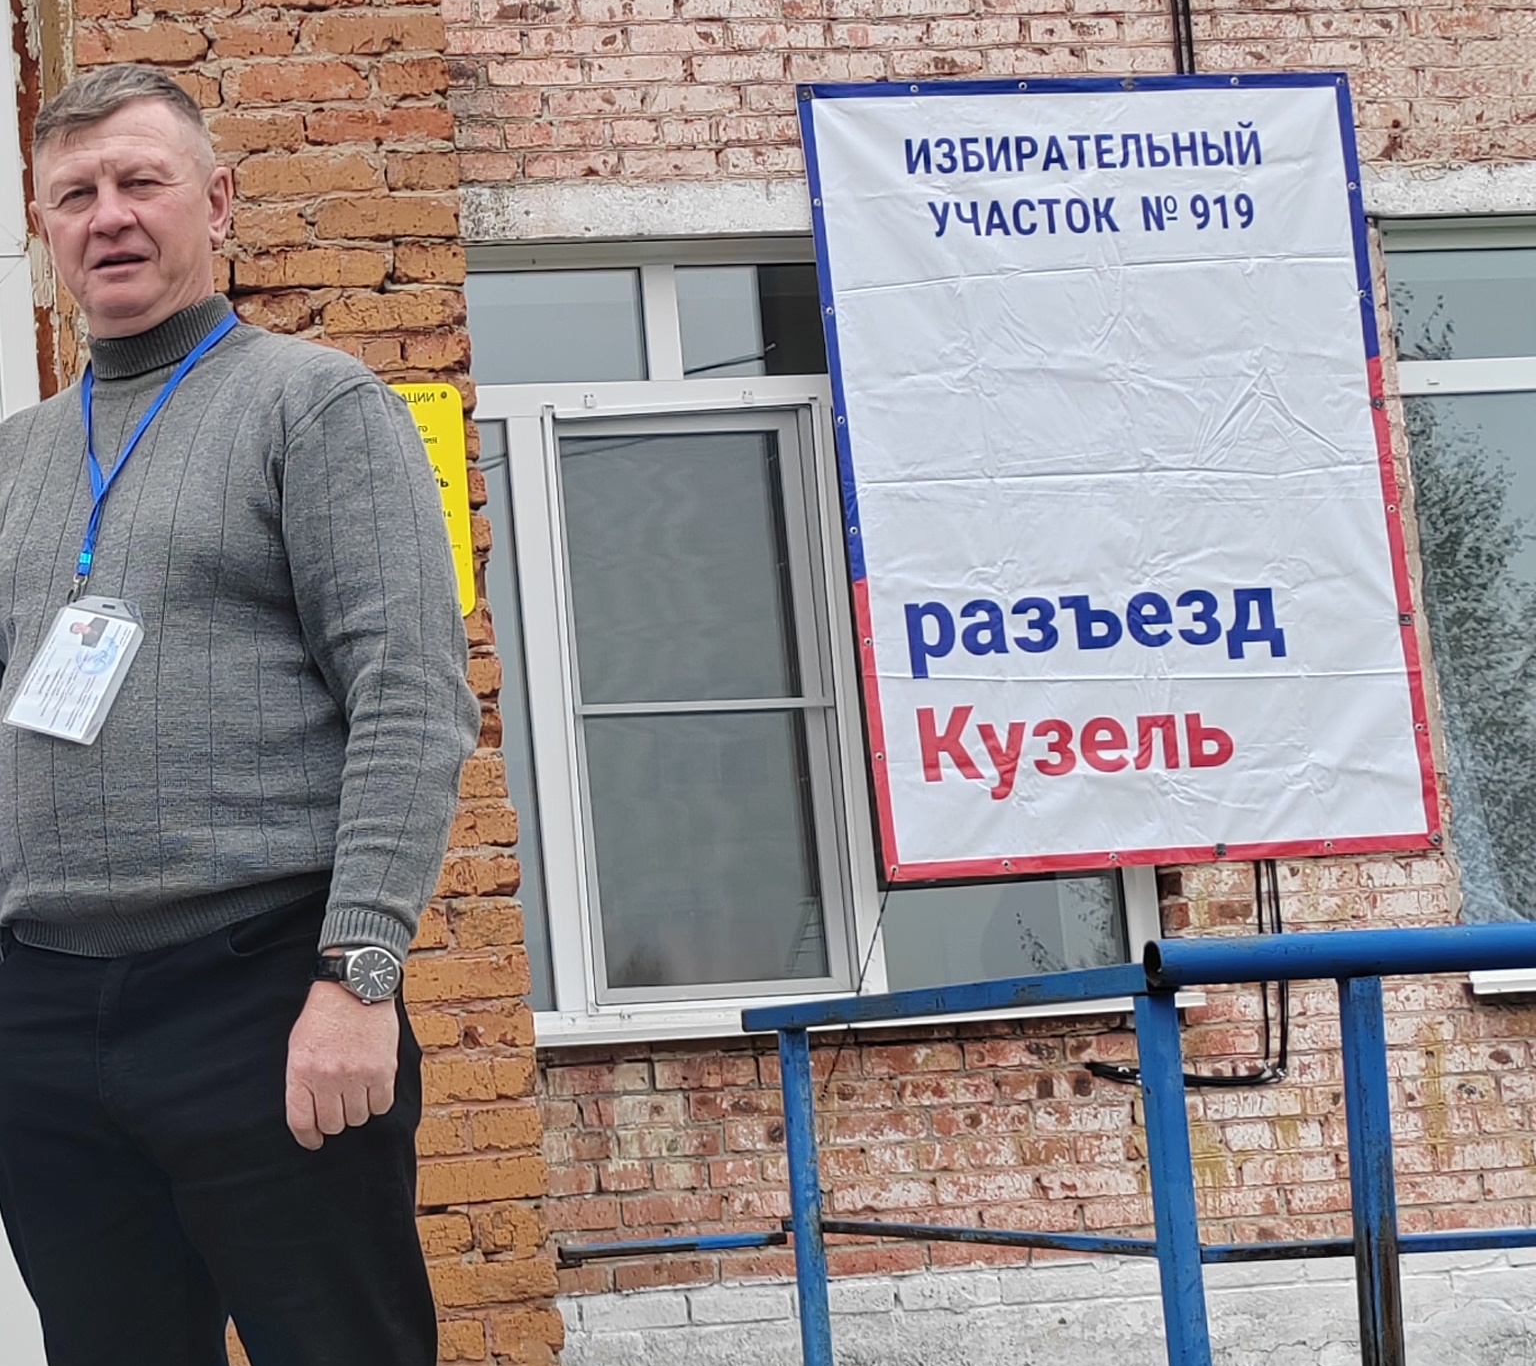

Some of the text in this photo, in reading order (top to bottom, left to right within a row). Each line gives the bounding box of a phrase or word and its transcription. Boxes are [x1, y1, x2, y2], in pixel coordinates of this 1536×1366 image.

[905, 122, 1263, 176] ИЗБИРАТЕЛЬНЫЙ
[929, 196, 1121, 238] УЧАСТОК
[1190, 192, 1256, 231] 919
[905, 587, 1288, 680] разъезд
[917, 704, 1235, 801] Кузель
